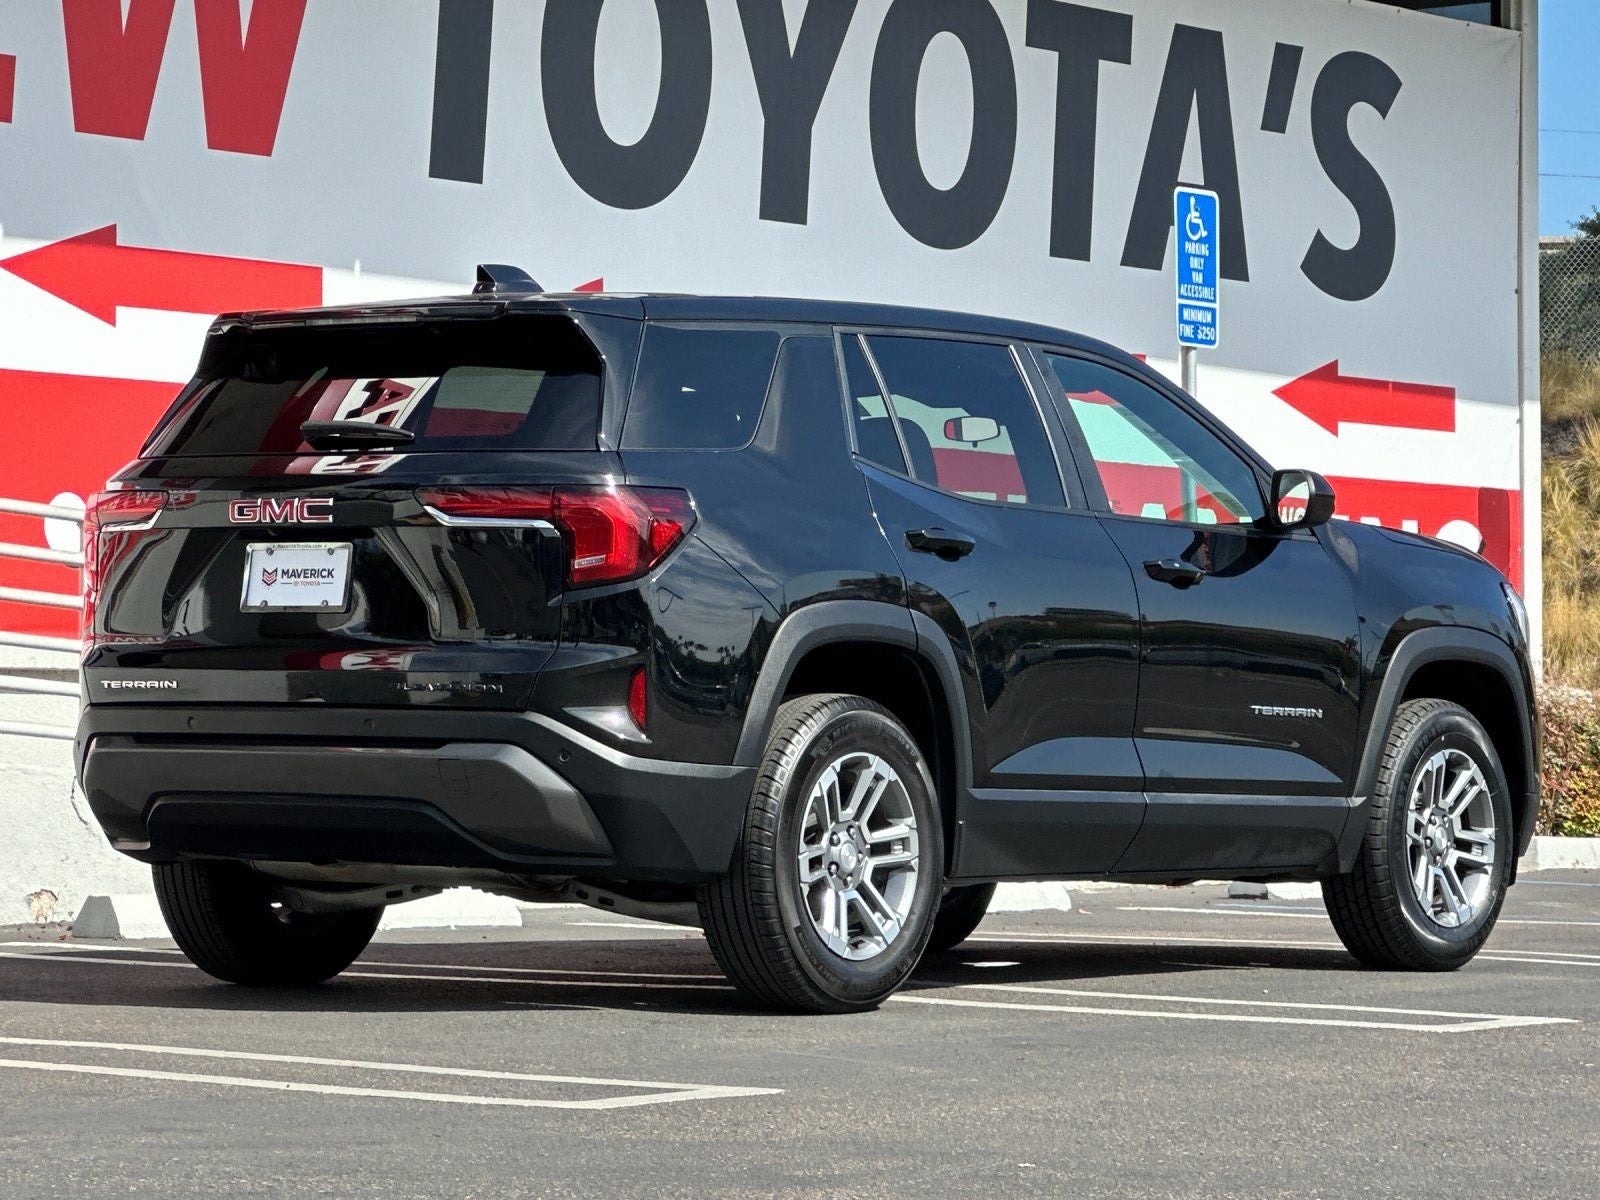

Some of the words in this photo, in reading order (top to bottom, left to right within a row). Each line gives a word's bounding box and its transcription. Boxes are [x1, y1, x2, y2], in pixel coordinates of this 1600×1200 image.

[1185, 241, 1209, 257] PARKING
[1189, 256, 1205, 270] ONLY
[1192, 271, 1203, 284] VAN
[1180, 284, 1214, 300] ACCESSIBLE
[1183, 307, 1212, 324] MINIMUM
[1179, 323, 1195, 338] FINE
[1196, 324, 1216, 341] $250
[229, 498, 334, 523] GMC
[281, 568, 335, 579] MAVERICK
[100, 680, 178, 689] TERRAIN
[1250, 705, 1323, 719] TERRAIN
